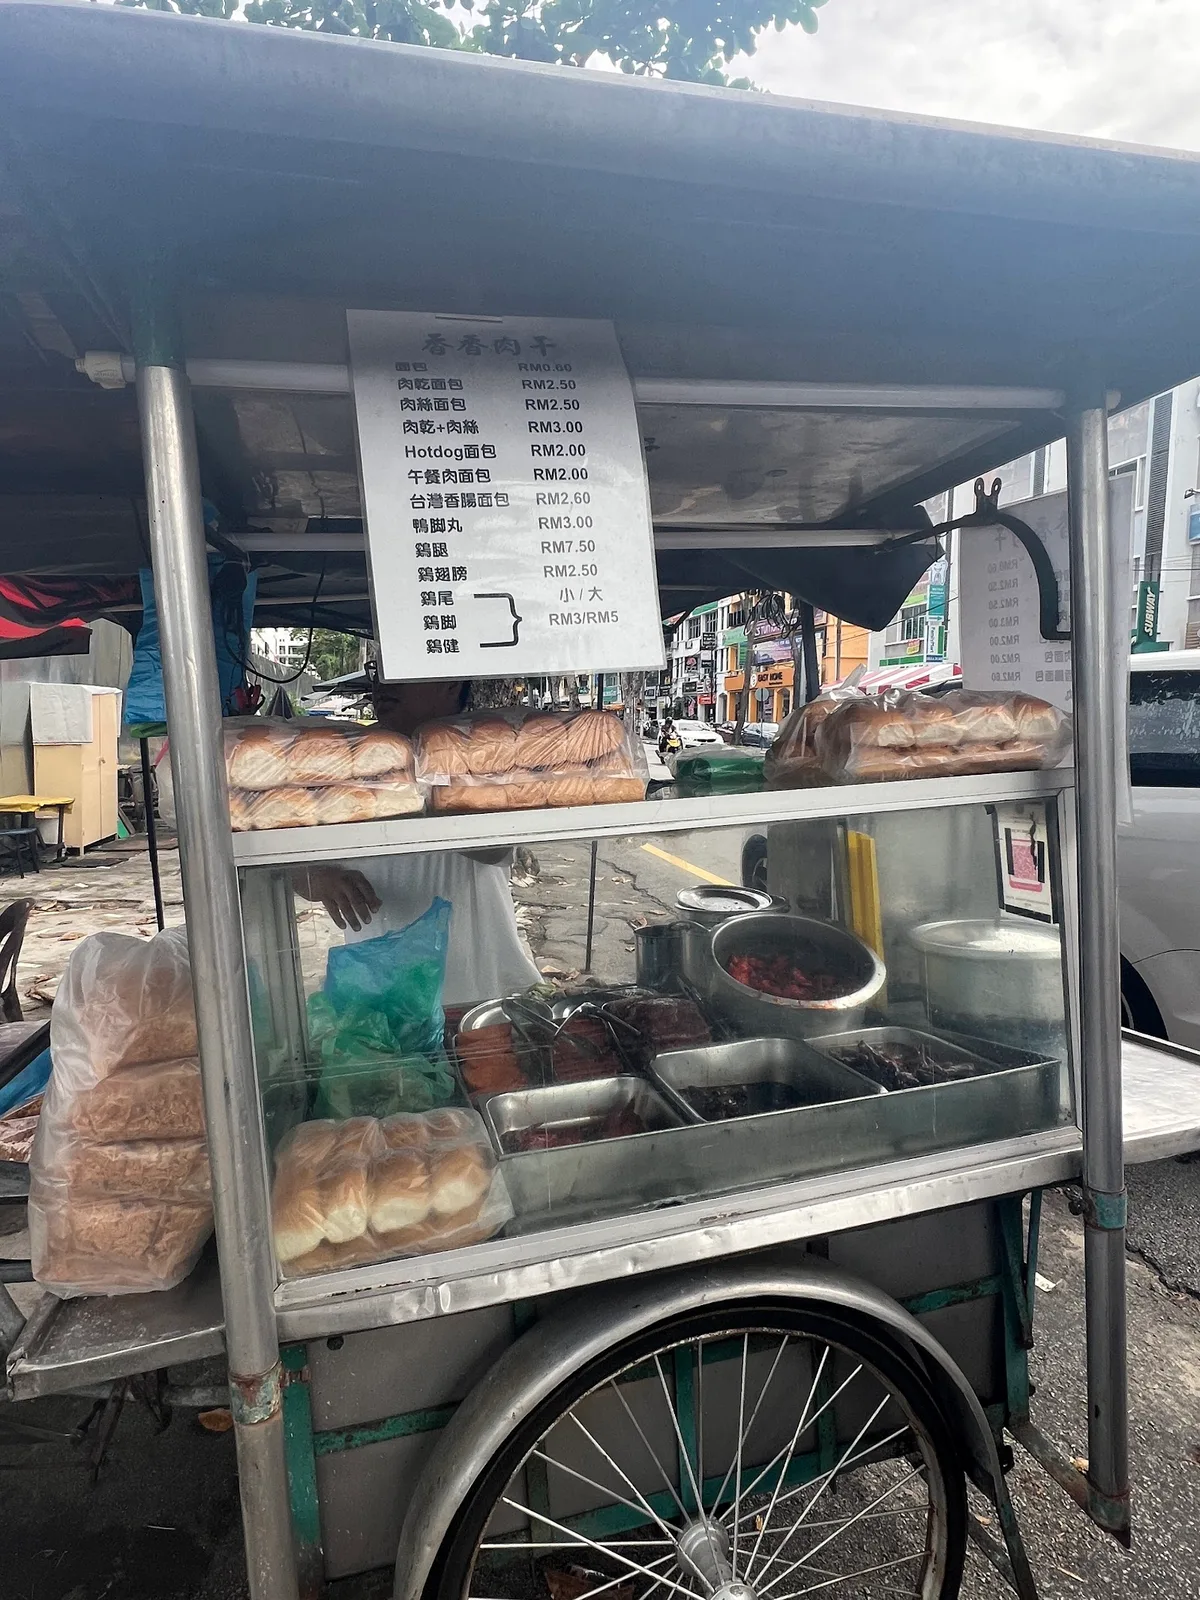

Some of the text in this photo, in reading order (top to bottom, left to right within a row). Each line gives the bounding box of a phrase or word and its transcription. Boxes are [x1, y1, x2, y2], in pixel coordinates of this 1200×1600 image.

[522, 380, 576, 390] RM2.50
[525, 399, 579, 410] RM2.50
[528, 421, 582, 433] RM3.00
[405, 444, 585, 461] Hotdog面包 RM2.00
[408, 468, 588, 484] 午餐肉面包 RM2.00
[536, 492, 590, 505] RM2.60
[539, 516, 592, 529] RM3.00
[541, 540, 595, 554] RM7.50
[544, 564, 597, 578] RM2.50
[549, 611, 618, 625] RM3/RM5
[1144, 587, 1157, 636] SUBWAY
